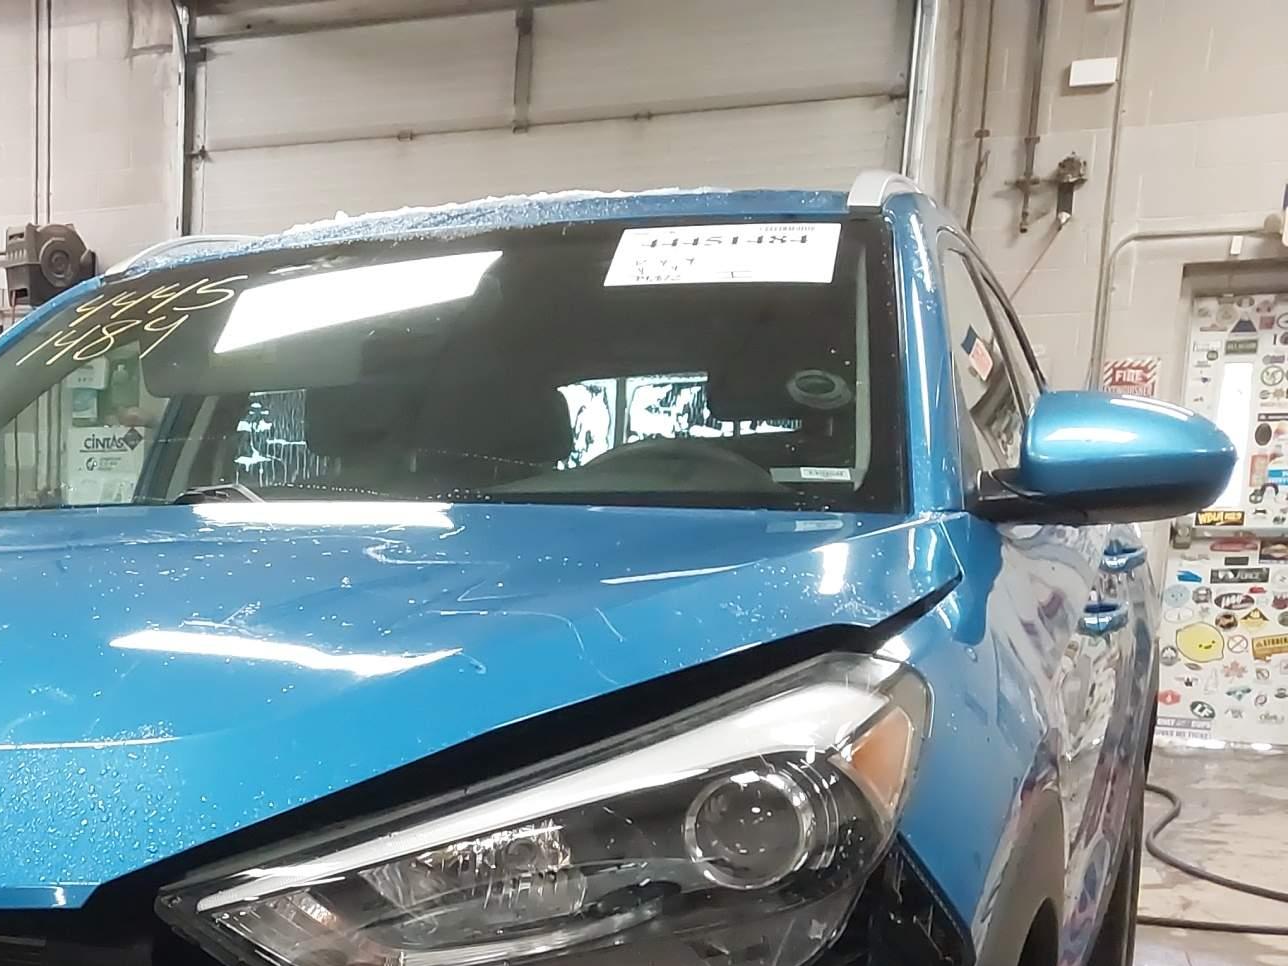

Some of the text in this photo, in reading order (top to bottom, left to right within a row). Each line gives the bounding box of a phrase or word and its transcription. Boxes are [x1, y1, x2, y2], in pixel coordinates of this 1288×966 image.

[68, 275, 249, 328] 4445
[16, 314, 190, 366] 1484
[1115, 369, 1146, 383] FIRE
